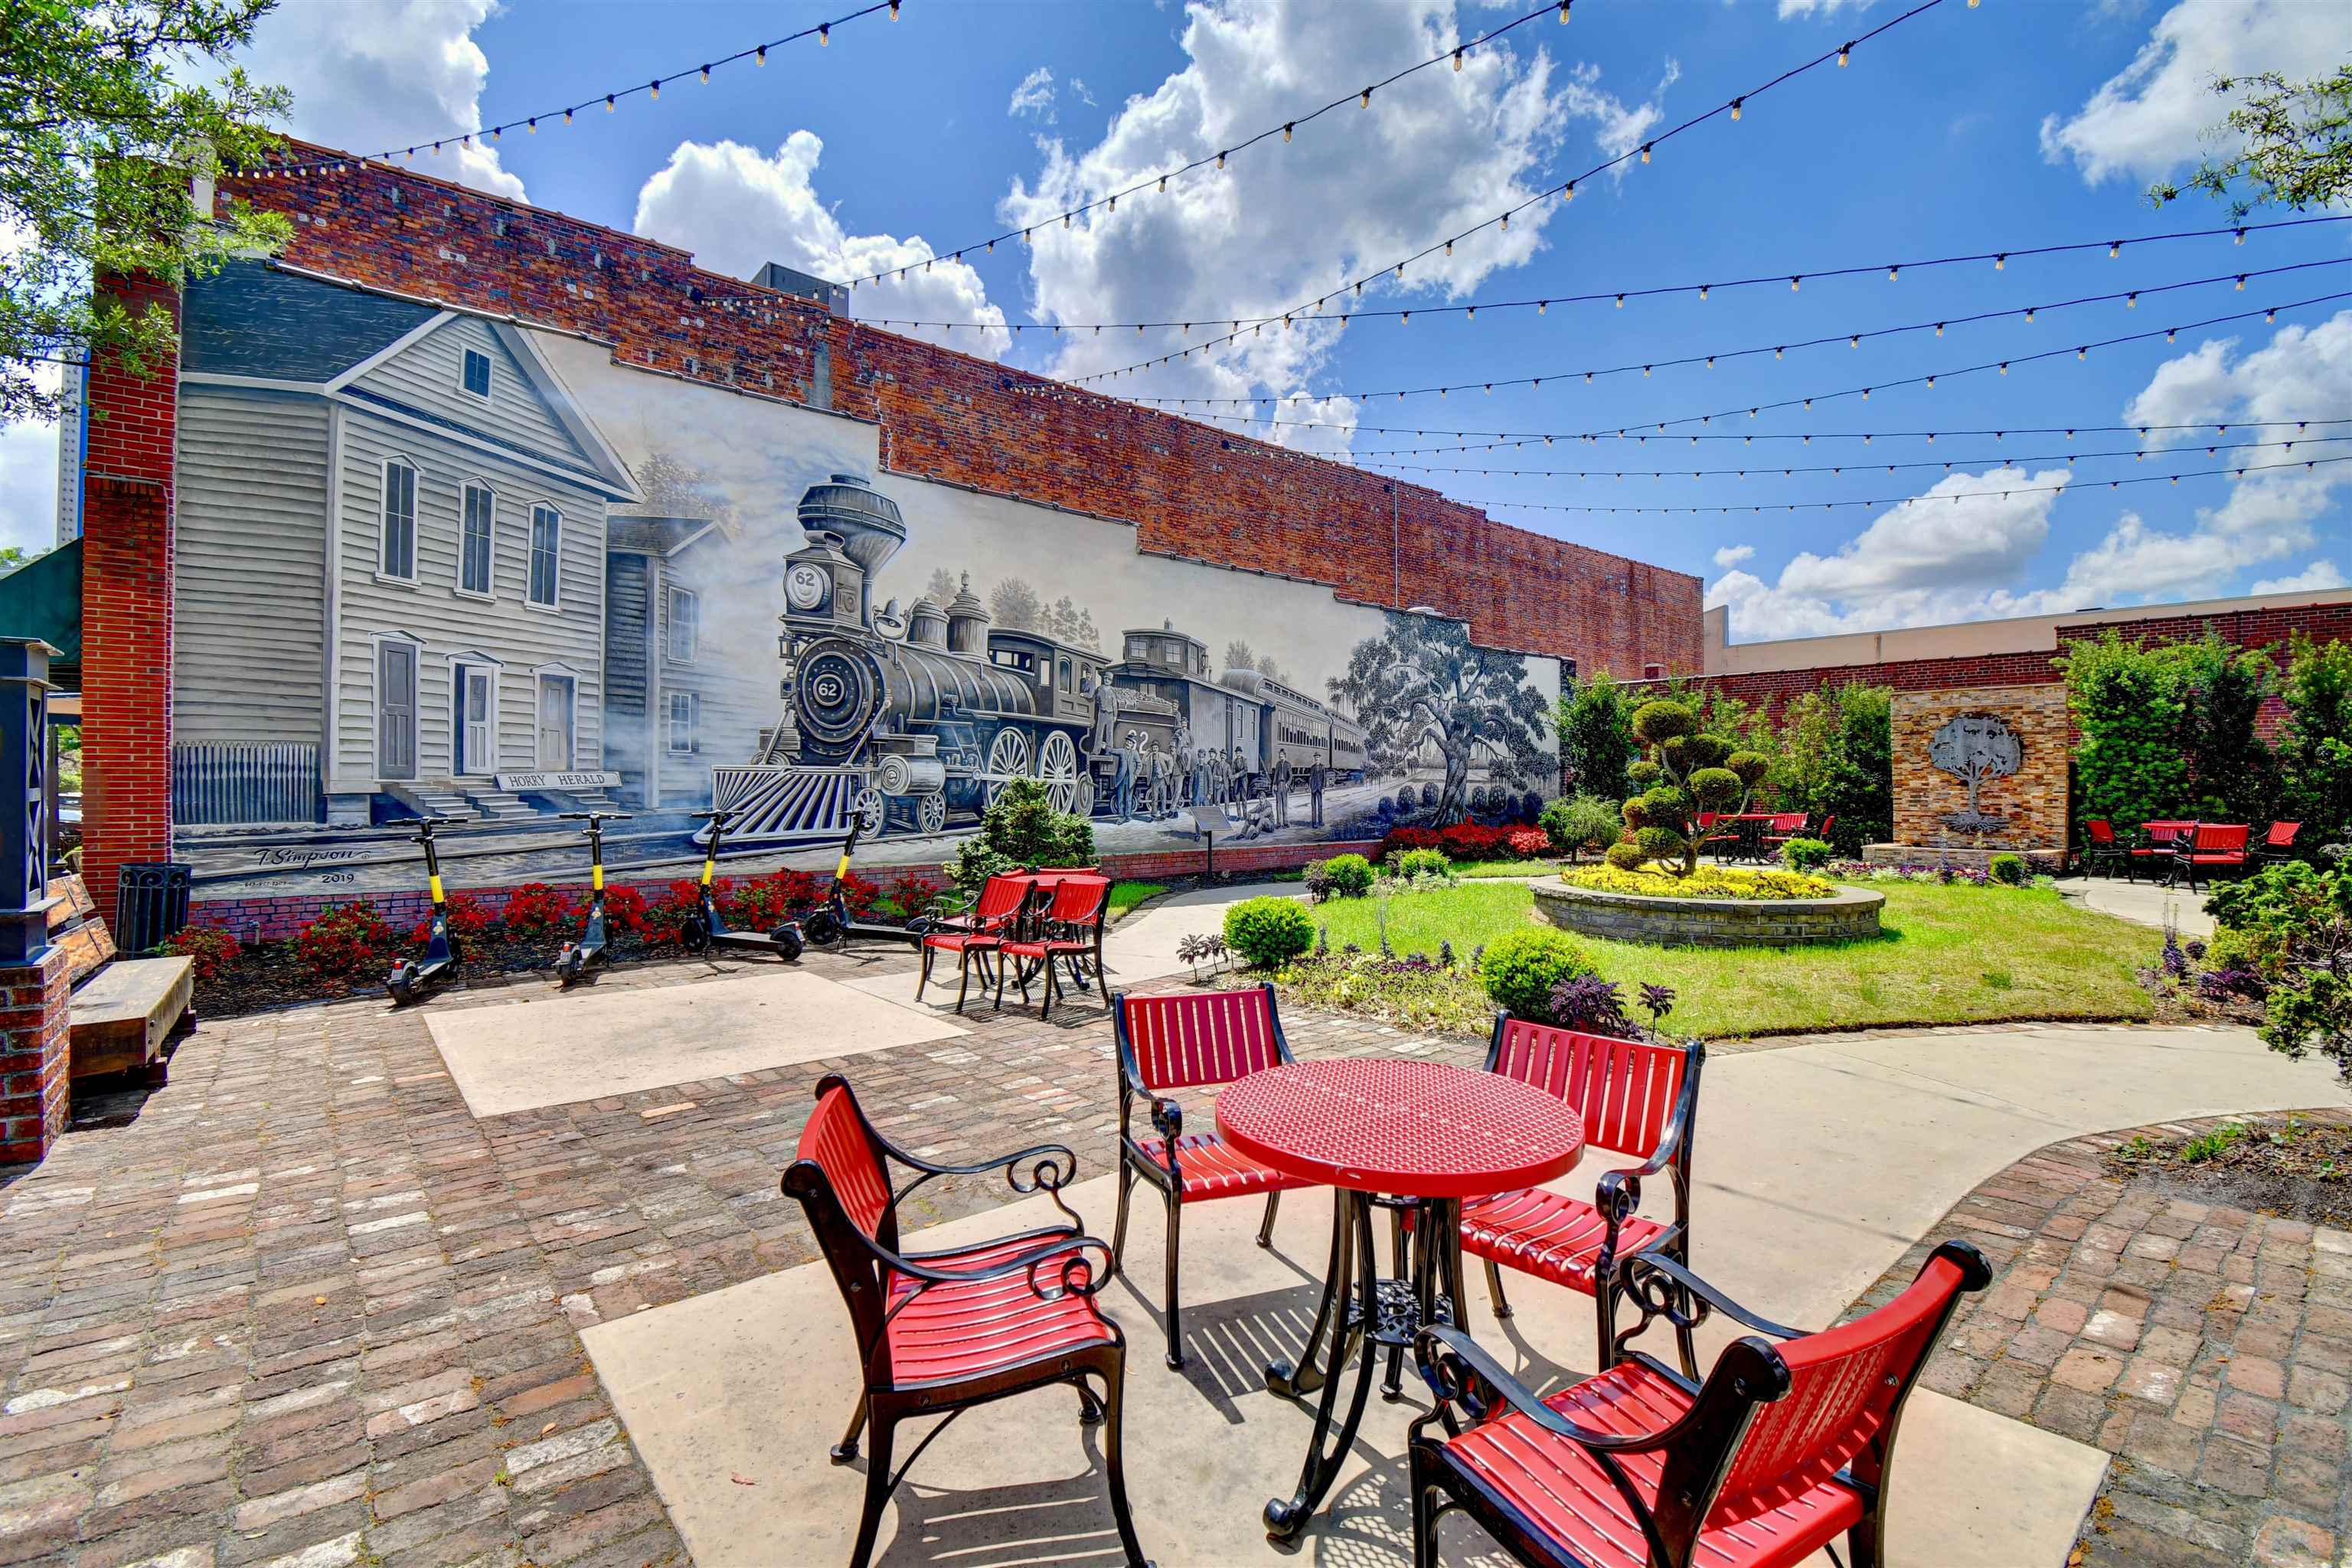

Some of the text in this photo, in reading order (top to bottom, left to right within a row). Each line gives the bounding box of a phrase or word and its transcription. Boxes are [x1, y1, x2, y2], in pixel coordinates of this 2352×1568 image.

[795, 571, 815, 587] 62
[818, 683, 837, 697] 62
[508, 774, 605, 787] HORRY HERALD
[271, 848, 369, 870] Simpson
[322, 874, 354, 884] 2019
